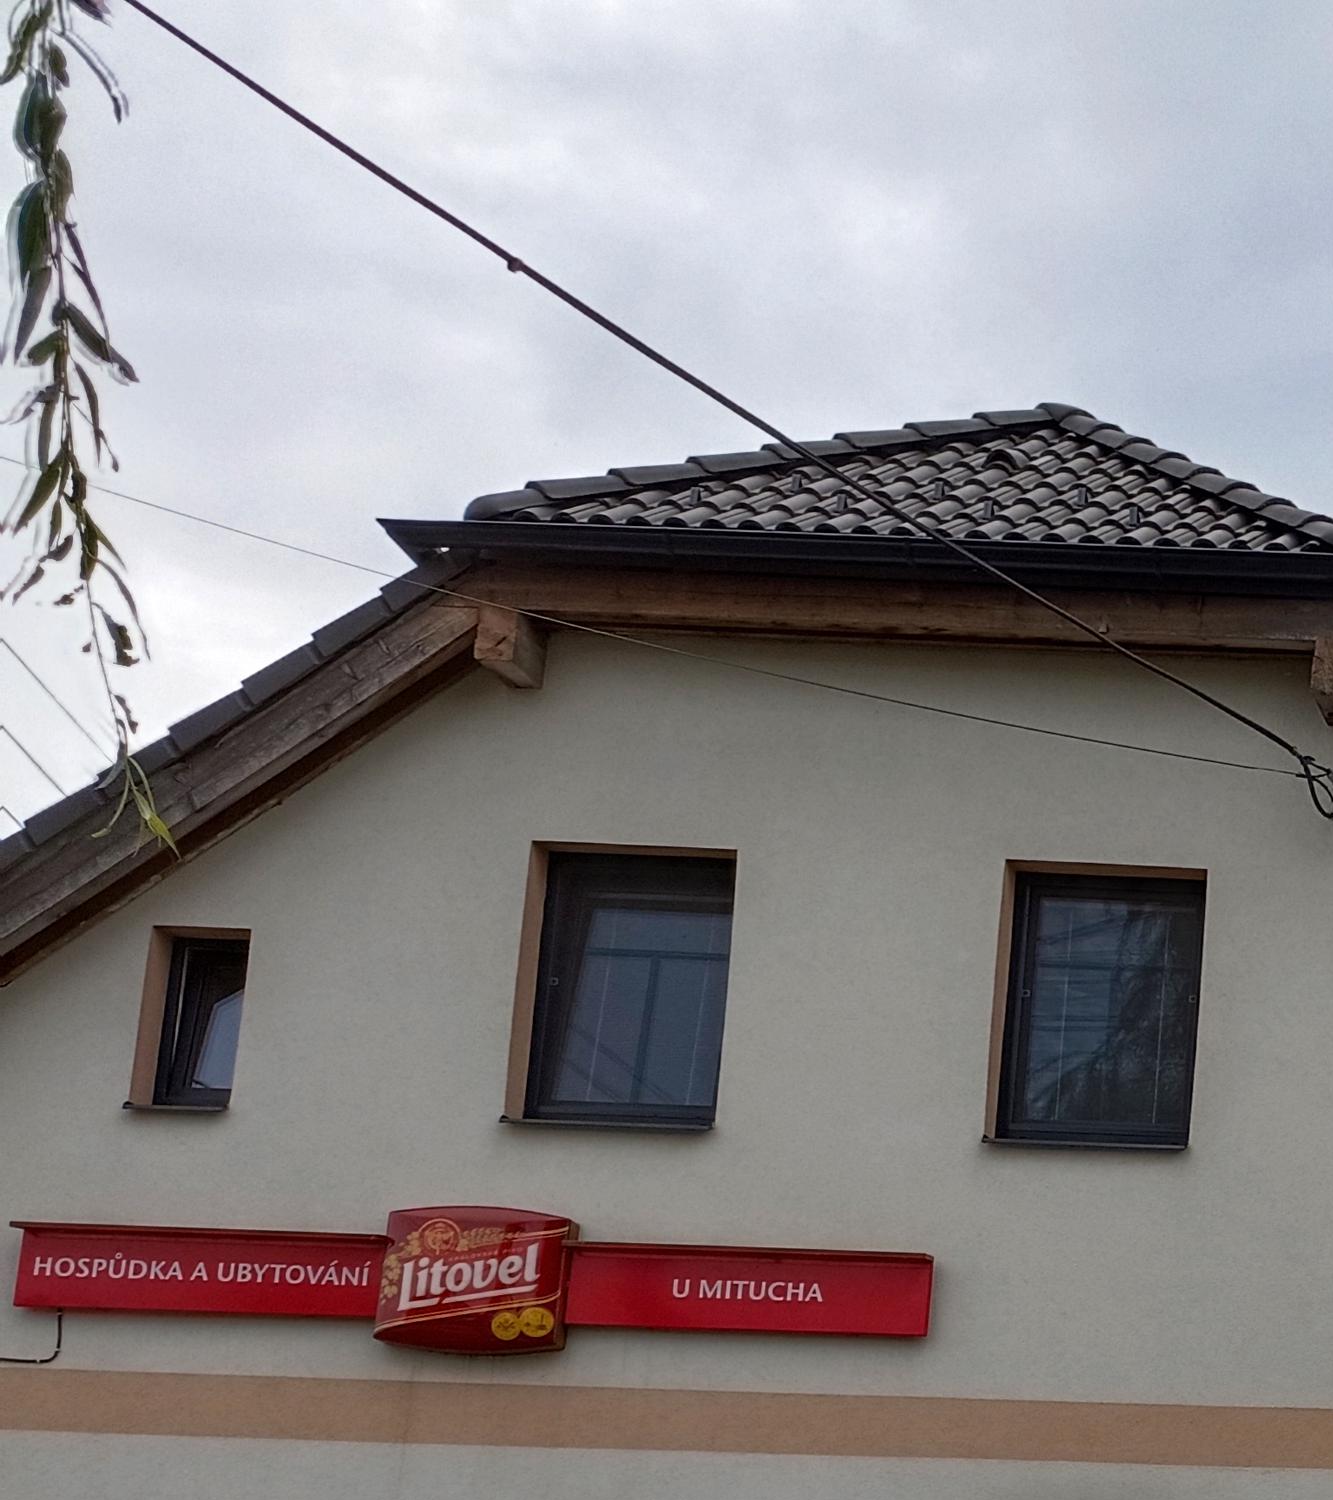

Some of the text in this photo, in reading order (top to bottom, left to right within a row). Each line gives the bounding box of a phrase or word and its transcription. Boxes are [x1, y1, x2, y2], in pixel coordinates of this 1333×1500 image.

[32, 1252, 371, 1287] HOSPŮDKA A UBYTOVÁNÍ
[397, 1242, 541, 1312] Litovel
[672, 1279, 824, 1303] U MITUCHA
